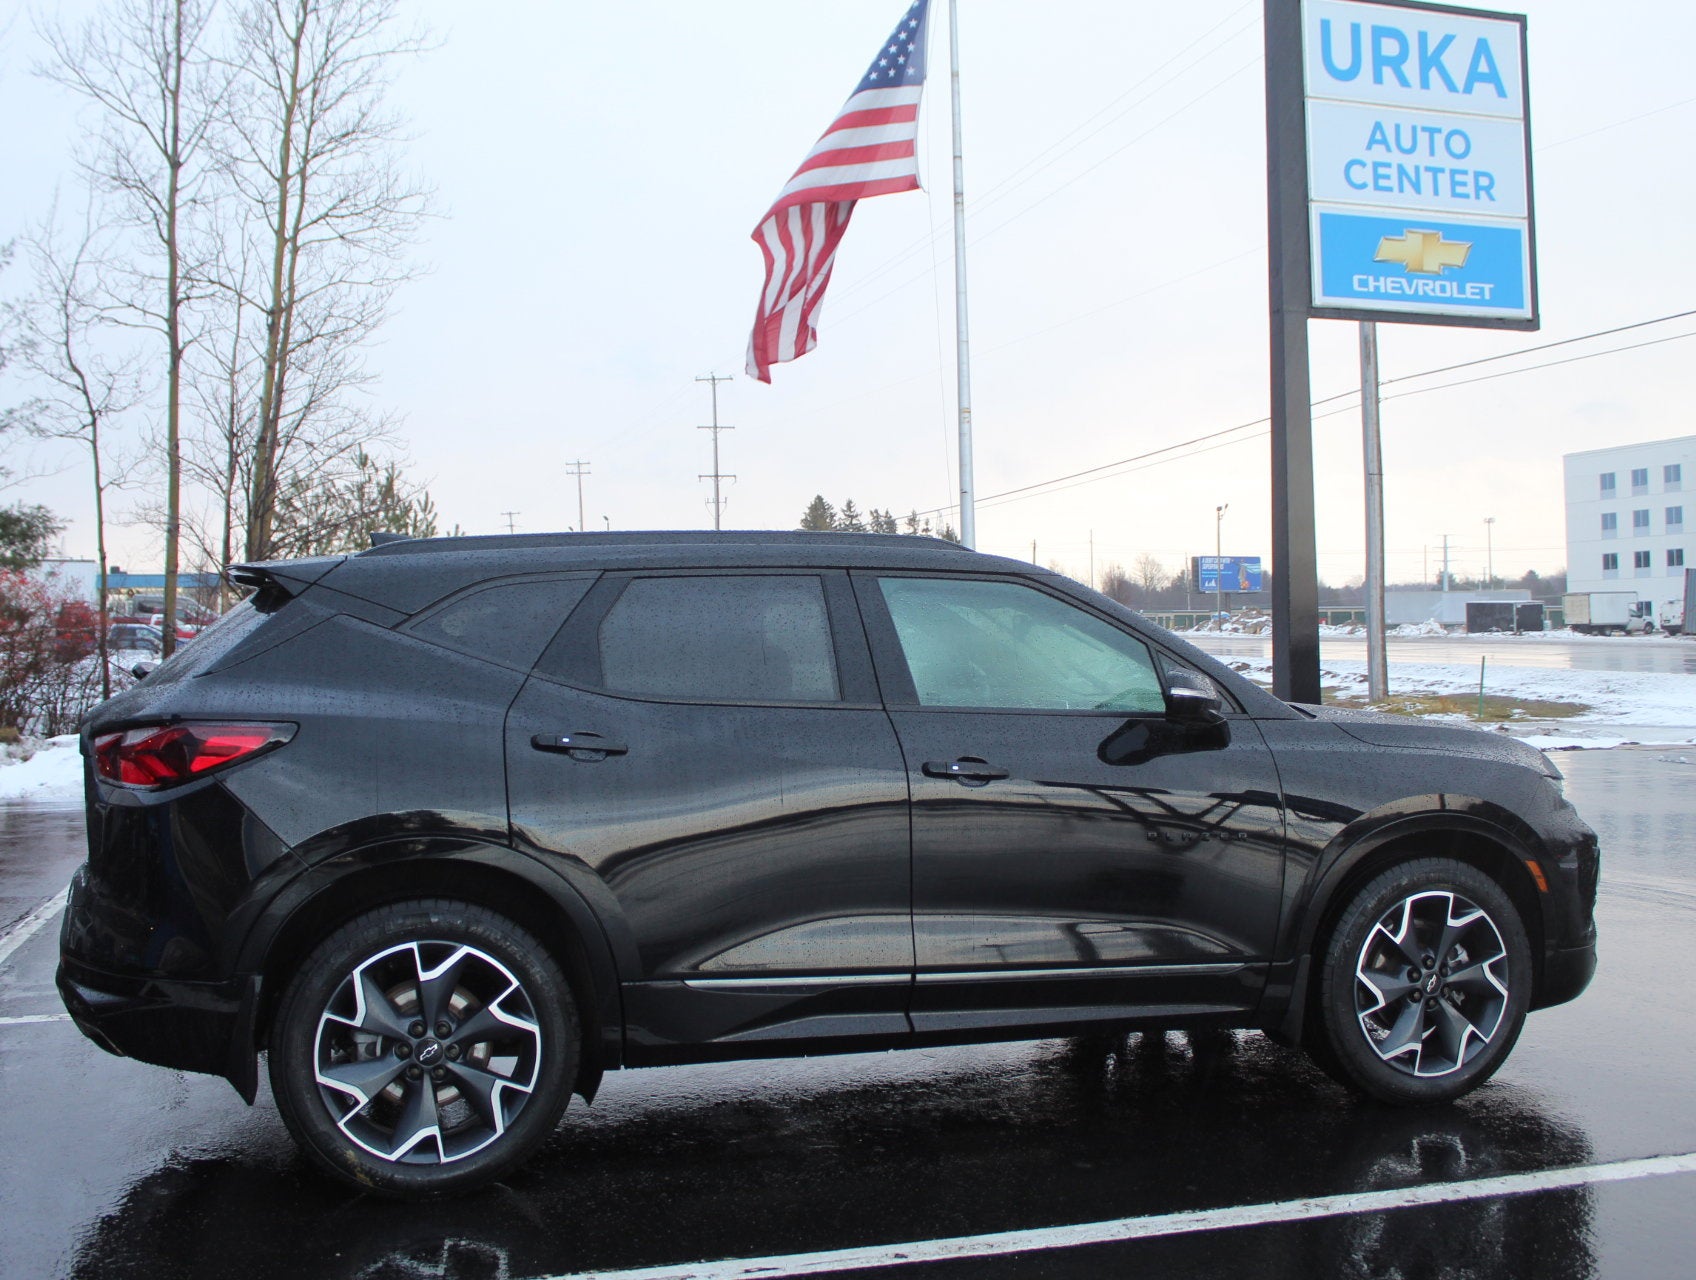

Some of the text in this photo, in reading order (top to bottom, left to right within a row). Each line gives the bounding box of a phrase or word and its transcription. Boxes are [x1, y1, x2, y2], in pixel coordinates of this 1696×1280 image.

[1320, 18, 1508, 99] URKA
[1365, 121, 1472, 160] AUTO
[1343, 159, 1496, 202] CENTER
[1352, 274, 1495, 300] CHEVROLET
[1146, 831, 1248, 842] BLAZER
